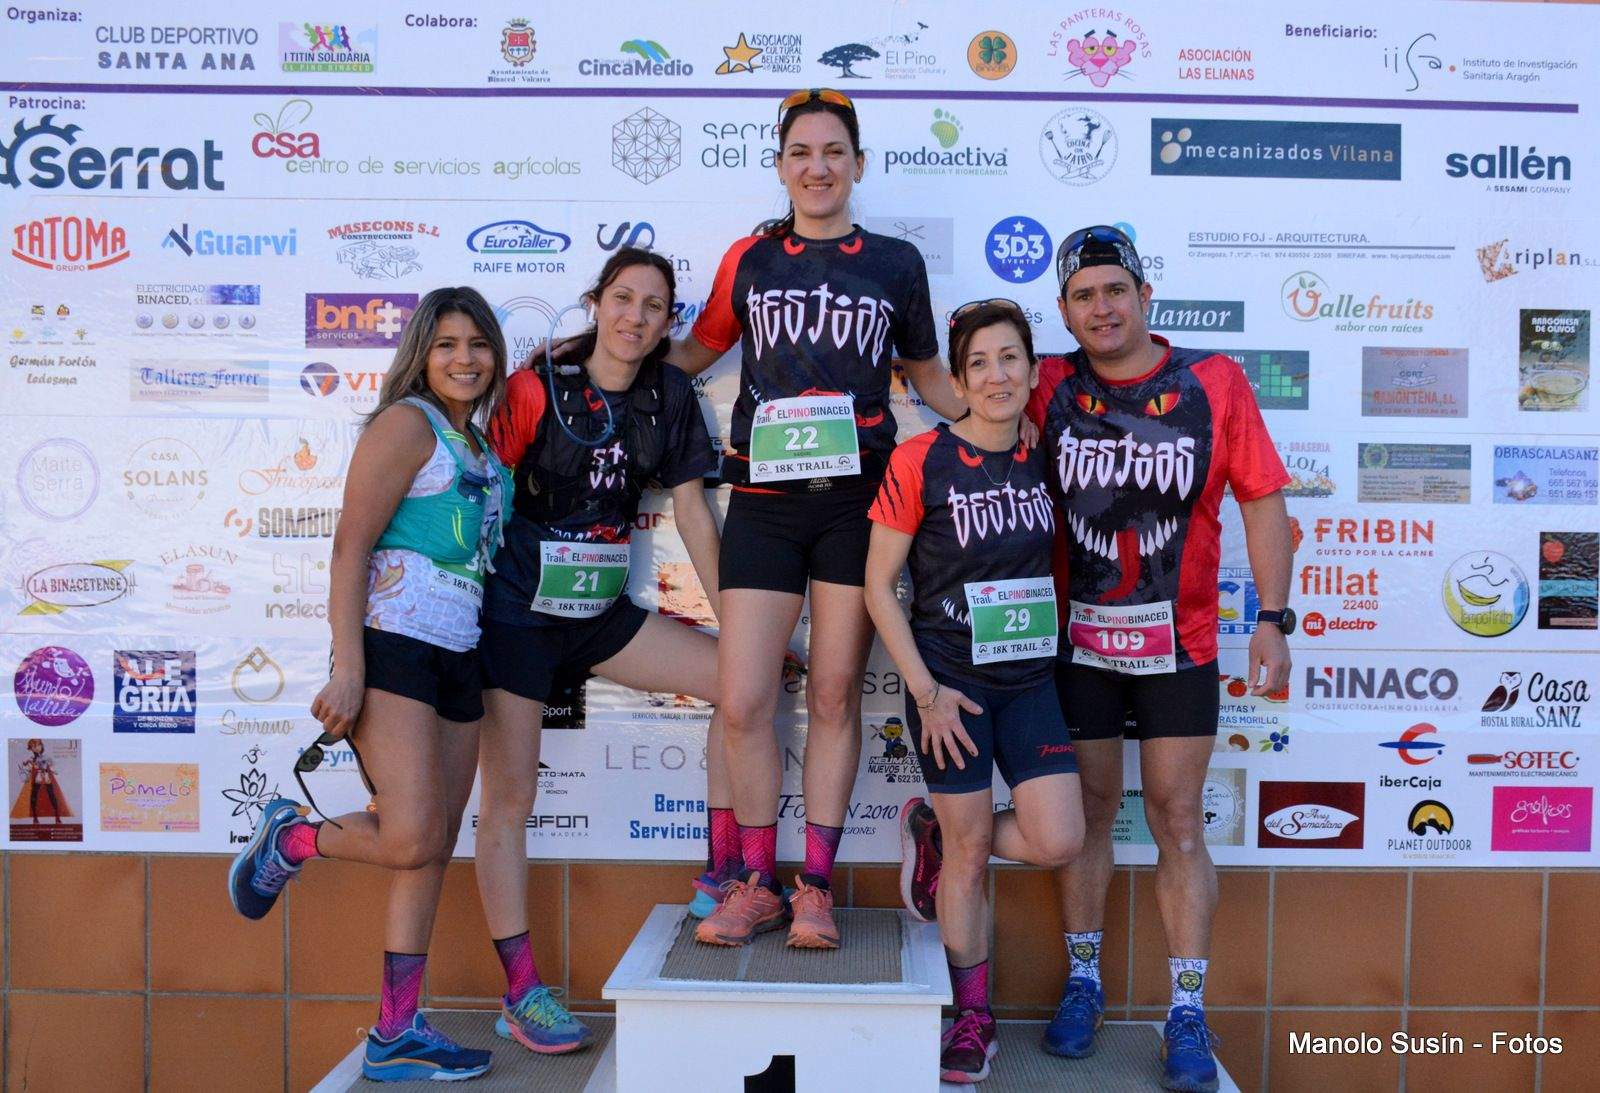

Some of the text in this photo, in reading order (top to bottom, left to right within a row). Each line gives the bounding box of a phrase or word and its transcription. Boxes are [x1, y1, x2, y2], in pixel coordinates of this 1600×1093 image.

[7, 7, 83, 23] Organiza:
[404, 14, 478, 28] Colabora:
[95, 26, 258, 46] CLUB DEPORTIVO
[1047, 8, 1152, 58] LAS PANTERAS ROSAS
[1285, 24, 1377, 38] Beneficiario:
[290, 52, 370, 63] TITIN SOLIDARIA
[765, 46, 802, 55] CULTURAL
[886, 50, 937, 65] El Pino
[1178, 47, 1252, 62] ASOCIACIÓN
[98, 52, 256, 71] SANTA ANA
[761, 55, 802, 64] BELENISTA
[1463, 58, 1578, 71] Instituto de Investigación
[490, 68, 539, 76] Ayuntamiento
[578, 59, 694, 77] CincaMedio
[771, 64, 802, 74] BINACED
[1178, 68, 1255, 81] LAS ELIANAS
[1463, 71, 1541, 83] Sanitaria Aragón
[8, 95, 86, 110] Patrocina:
[251, 130, 321, 159] csa
[1186, 142, 1394, 162] mecanizados Vilana
[701, 143, 748, 168] del
[884, 147, 1005, 174] podoactiva
[1064, 153, 1093, 165] JAIRO
[1445, 145, 1572, 181] sallén
[28, 139, 226, 191] serrat
[286, 156, 581, 180] centro de servicios agrícolas
[1494, 185, 1528, 193] SESAMI
[327, 220, 415, 240] MASECONS
[1188, 232, 1240, 243] ESTUDIO
[1243, 233, 1265, 243] FOJ
[13, 216, 127, 262] TATOMA
[194, 228, 297, 257] Guarvi
[483, 234, 557, 250] EuroTaller
[993, 234, 1045, 259] 3D3
[55, 264, 86, 272] GRUPO
[473, 262, 566, 273] RAIFE MOTOR
[136, 284, 206, 293] ELECTRICIDAD
[1334, 322, 1424, 333] sabor con raíces
[1535, 325, 1576, 333] DE OLIVOS
[140, 367, 207, 386] Talleres
[777, 405, 850, 419] ELPINOBINACED
[784, 426, 819, 451] 22
[151, 452, 179, 461] CASA
[1493, 446, 1599, 461] OBRASCALASANZ
[775, 460, 833, 474] 18K TRAIL
[1285, 454, 1330, 478] LOLA
[31, 474, 84, 492] Serra
[123, 470, 209, 487] SOLANS
[1314, 517, 1434, 545] FRIBIN
[546, 552, 628, 563] Trail ELPINOBINACED
[1316, 548, 1434, 557] GUSTO POR LA CARNE
[33, 577, 123, 593] LA BINACETENSE
[453, 578, 469, 591] 18K
[571, 570, 600, 592] 21
[1300, 565, 1379, 597] fillat
[971, 587, 1054, 605] Trail ELPINOBINACED
[558, 602, 576, 611] 18K
[1342, 599, 1379, 611] 22400
[1003, 608, 1031, 633] 29
[1074, 611, 1169, 625] Trail ELPINOBINACED
[1328, 619, 1378, 632] electro
[1096, 630, 1146, 651] 109
[992, 642, 1038, 655] 18K TRAIL
[1112, 659, 1150, 670] TRAIL
[121, 659, 183, 687] ALE
[1527, 672, 1591, 703] Casa
[118, 686, 193, 713] GRIA
[220, 709, 294, 736] Serrano
[1239, 716, 1278, 725] MORILLO
[1480, 705, 1583, 729] HOSTAL RURAL SANZ
[604, 744, 686, 771] LEO
[1504, 751, 1577, 769] SOTEC
[868, 766, 900, 774] NUEVOS
[1379, 775, 1442, 792] iberCaja
[861, 804, 899, 820] 2010
[1266, 817, 1280, 828] del
[1387, 839, 1472, 851] PLANET OUTDOOR
